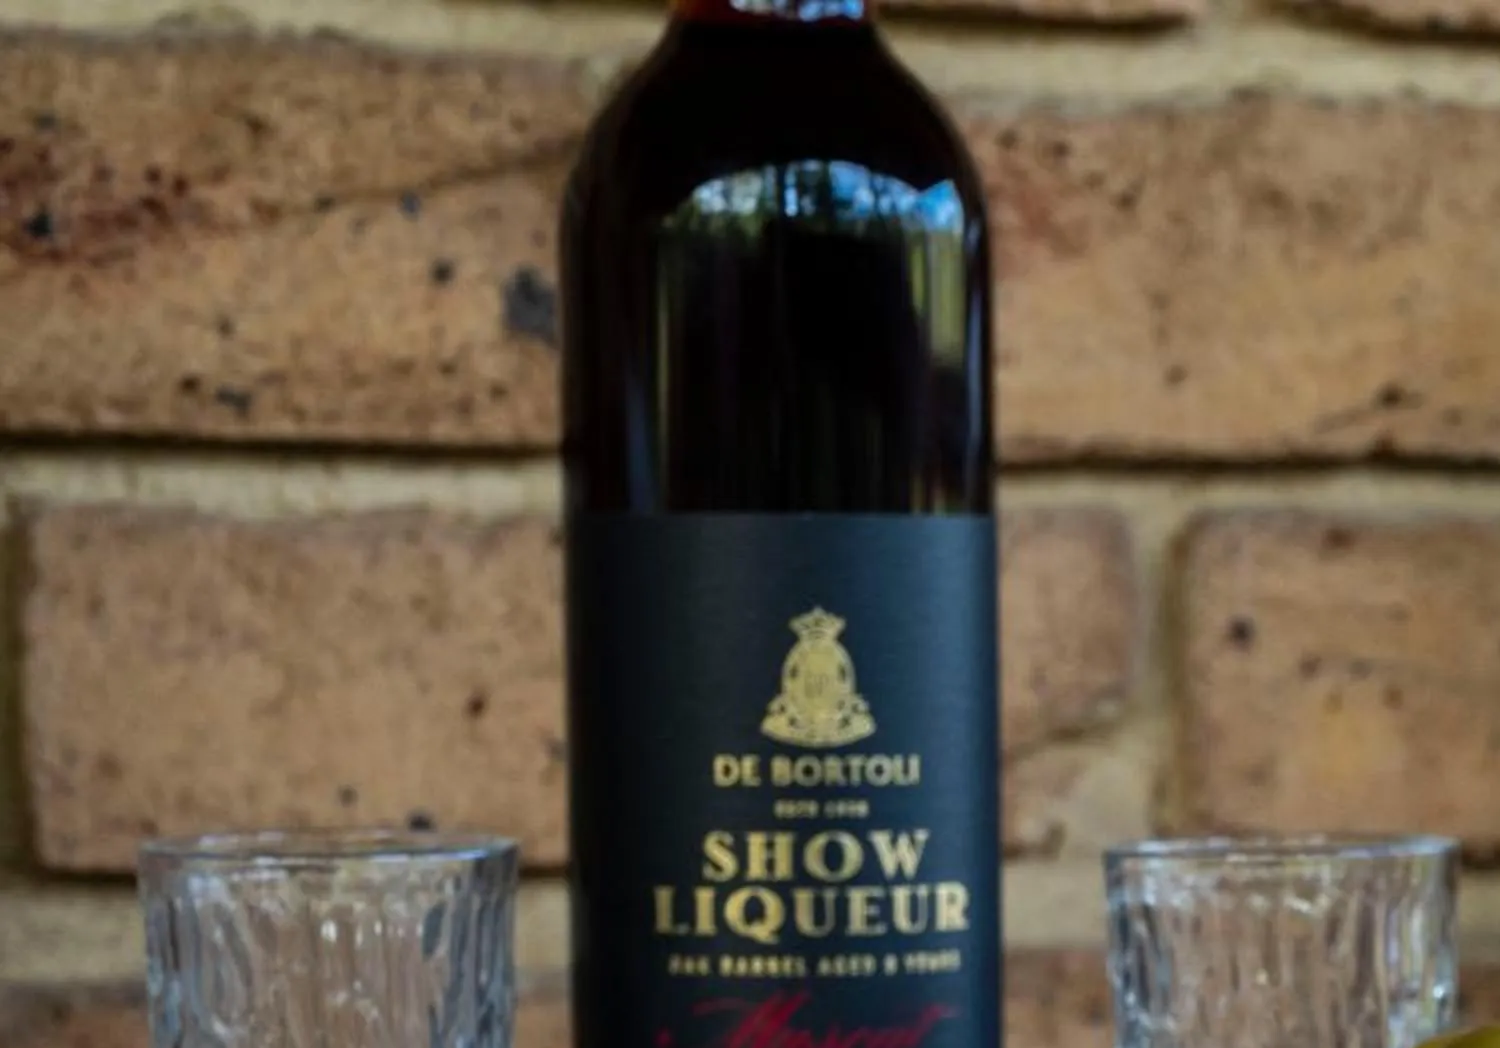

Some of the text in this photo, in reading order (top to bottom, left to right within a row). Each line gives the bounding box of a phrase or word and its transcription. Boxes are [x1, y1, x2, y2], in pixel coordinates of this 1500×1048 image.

[712, 753, 921, 787] DE BORTOLI
[703, 829, 929, 882] SHOW
[655, 882, 970, 944] LIQUEUR
